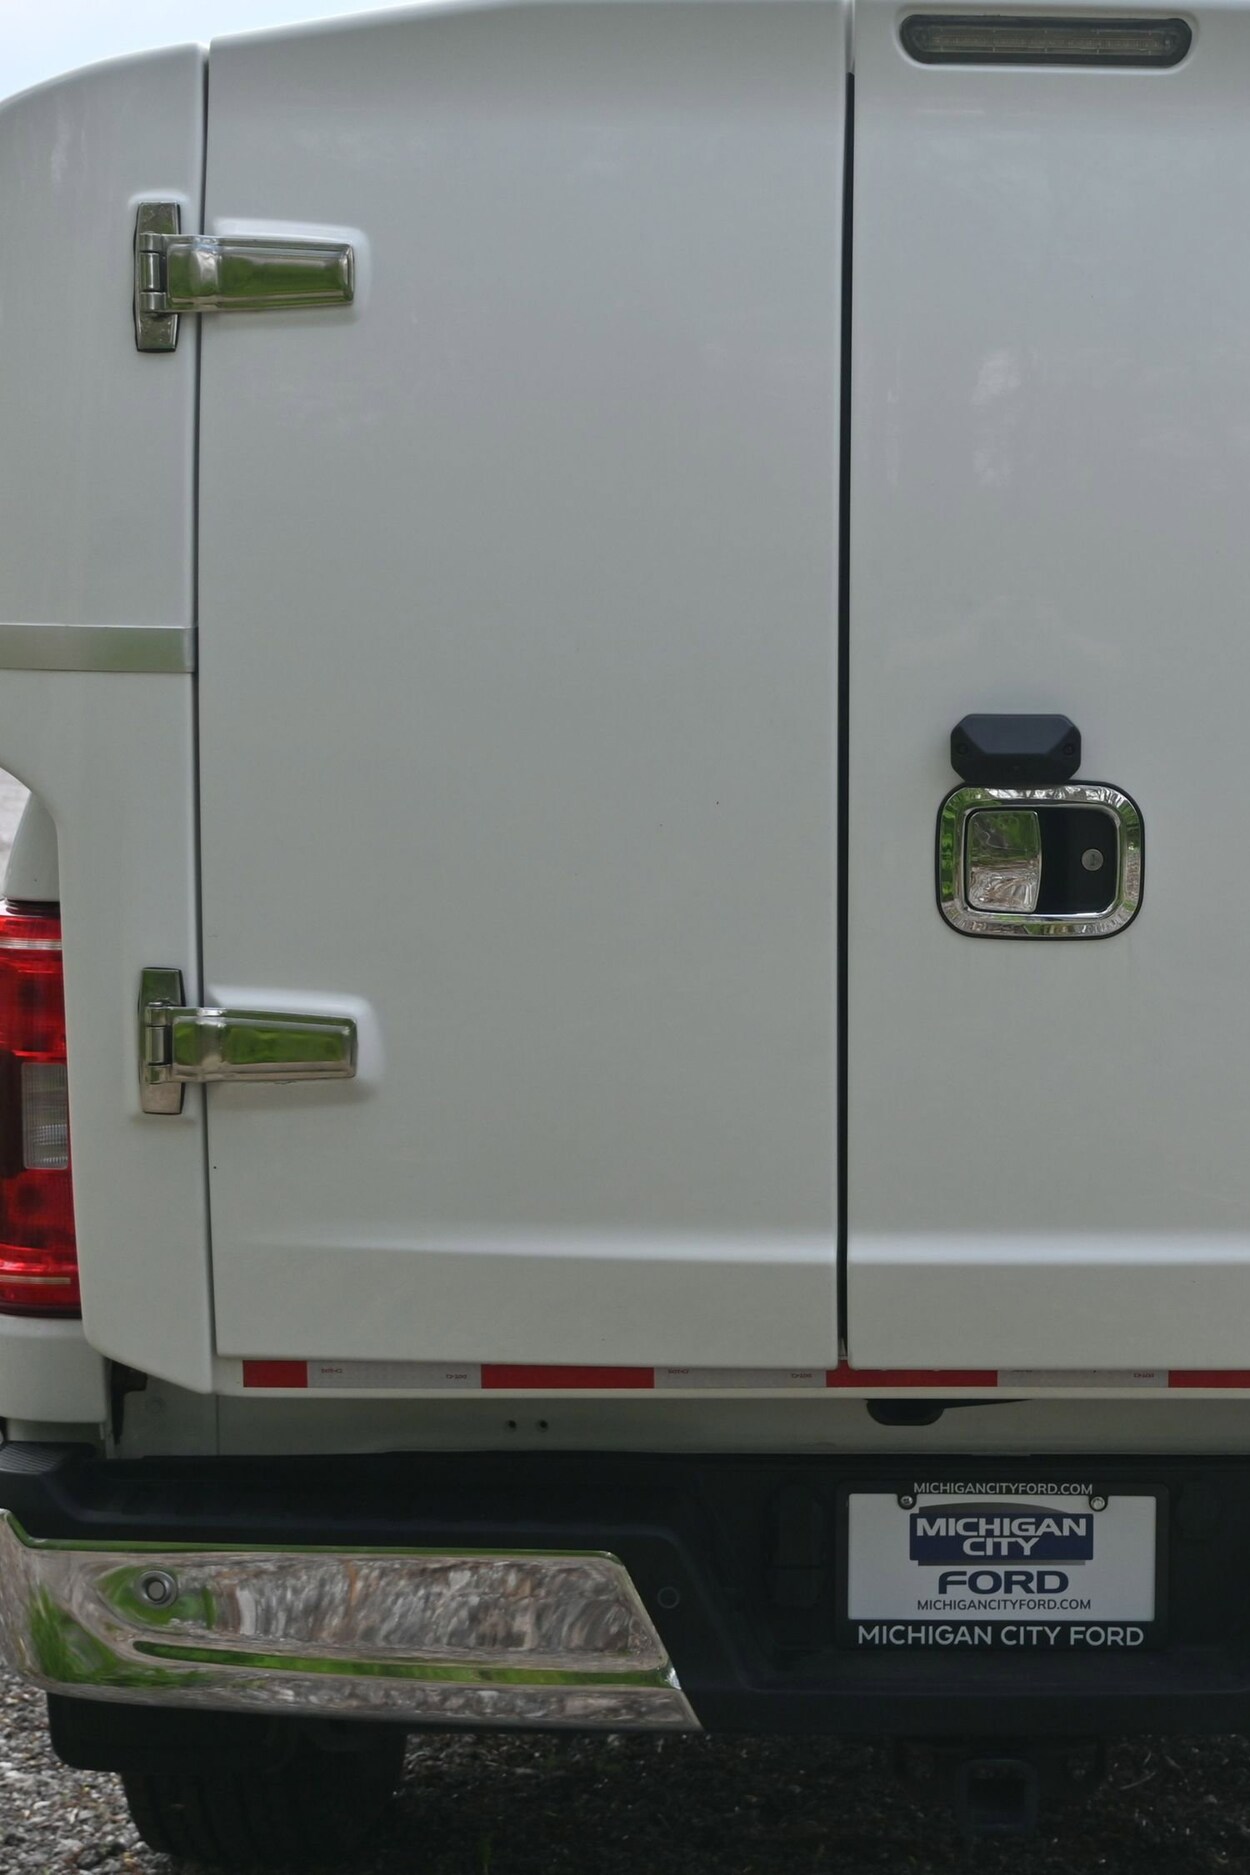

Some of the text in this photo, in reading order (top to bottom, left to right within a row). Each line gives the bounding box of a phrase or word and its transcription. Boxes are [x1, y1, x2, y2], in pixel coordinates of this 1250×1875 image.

[913, 1482, 1093, 1495] MICHIGANCITYFORD.COM
[916, 1517, 1086, 1537] MICHIGAN
[962, 1537, 1040, 1556] CITY
[938, 1570, 1069, 1595] FORD
[917, 1599, 1091, 1611] MICHIGANCITYFORD.COM
[857, 1625, 1144, 1646] MICHIGAN CITY FORD
